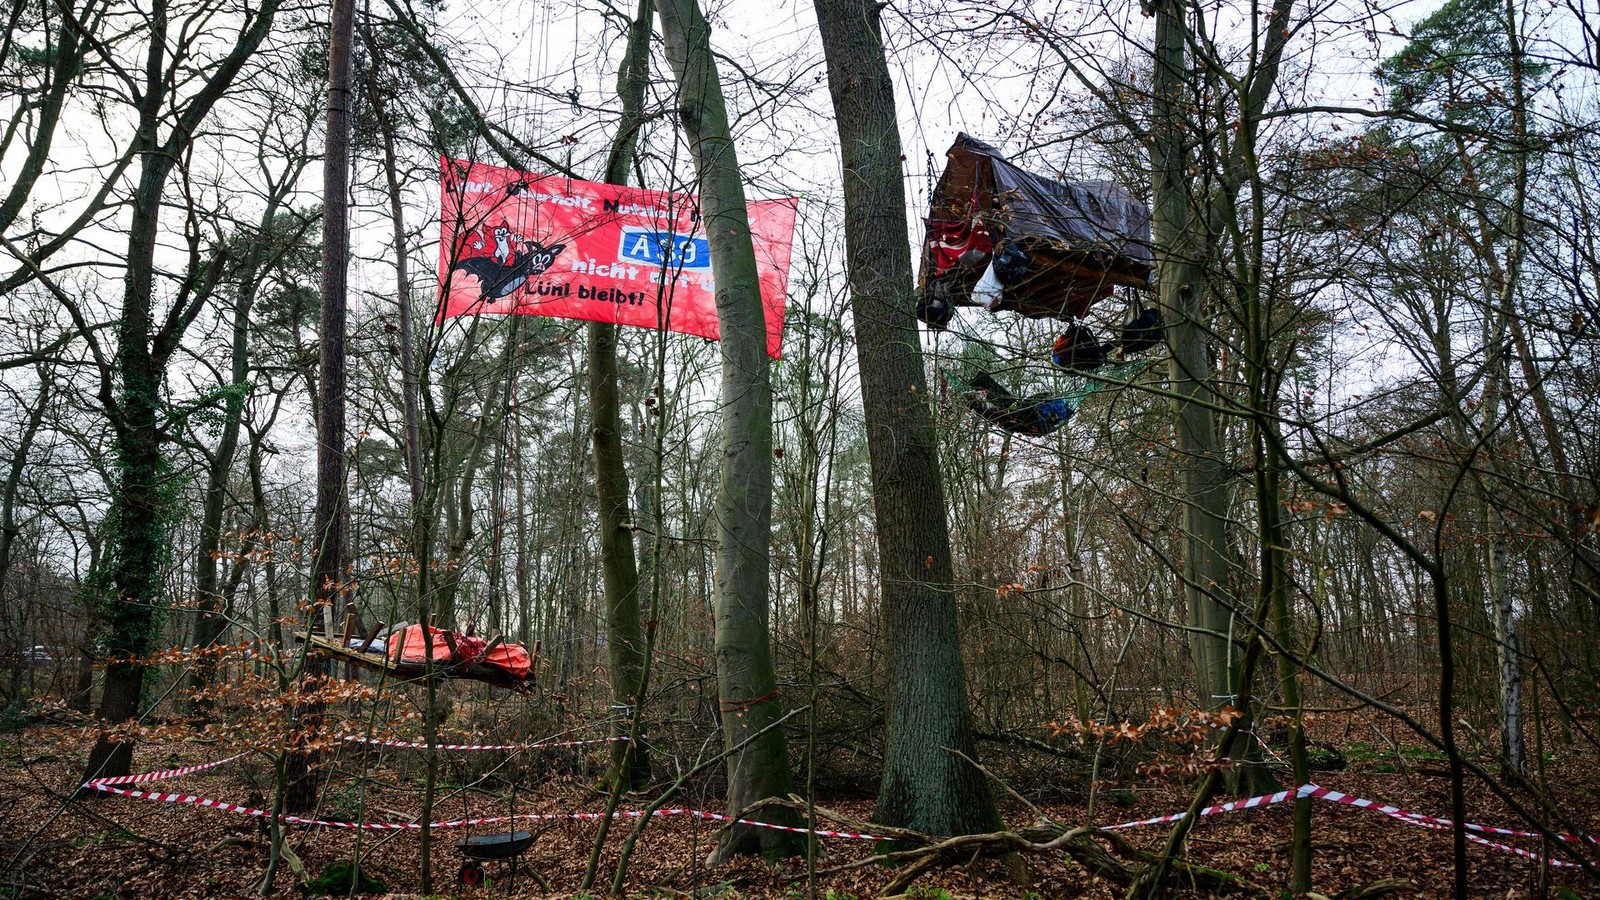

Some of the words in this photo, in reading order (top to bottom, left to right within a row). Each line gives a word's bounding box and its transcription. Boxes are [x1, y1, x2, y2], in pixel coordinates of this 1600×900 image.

[571, 258, 639, 280] nicht
[525, 281, 570, 297] Lüni
[578, 284, 645, 306] bleibt!
